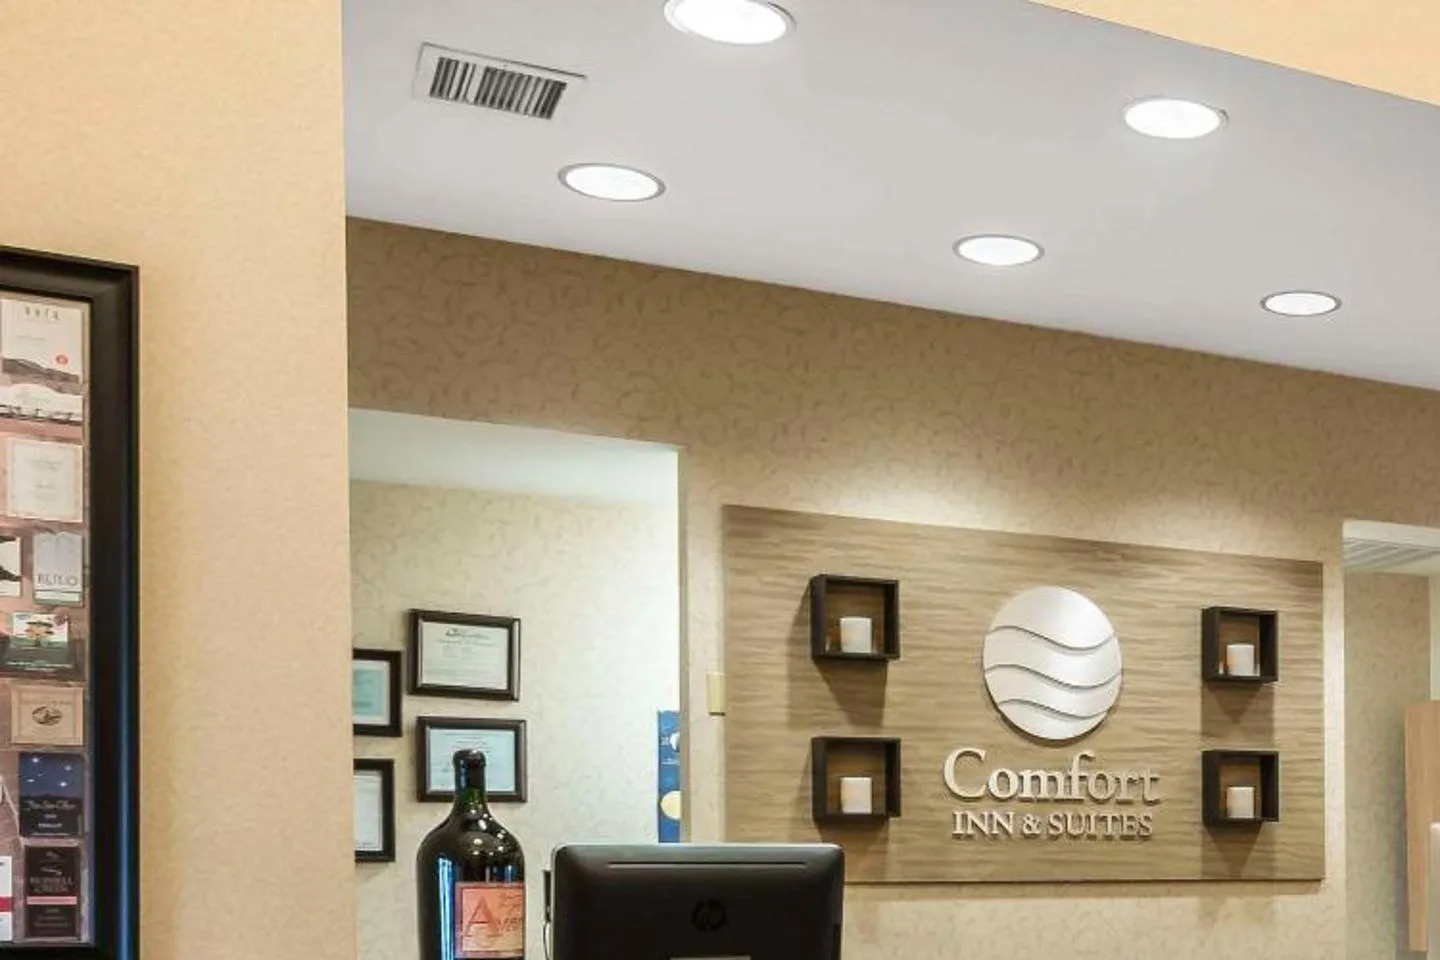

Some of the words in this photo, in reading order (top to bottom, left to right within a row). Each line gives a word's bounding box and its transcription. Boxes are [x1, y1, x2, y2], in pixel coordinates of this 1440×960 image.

[943, 747, 1161, 803] Comfort
[952, 811, 1015, 837] INN
[1022, 813, 1042, 837] &
[1048, 812, 1154, 839] SUITES
